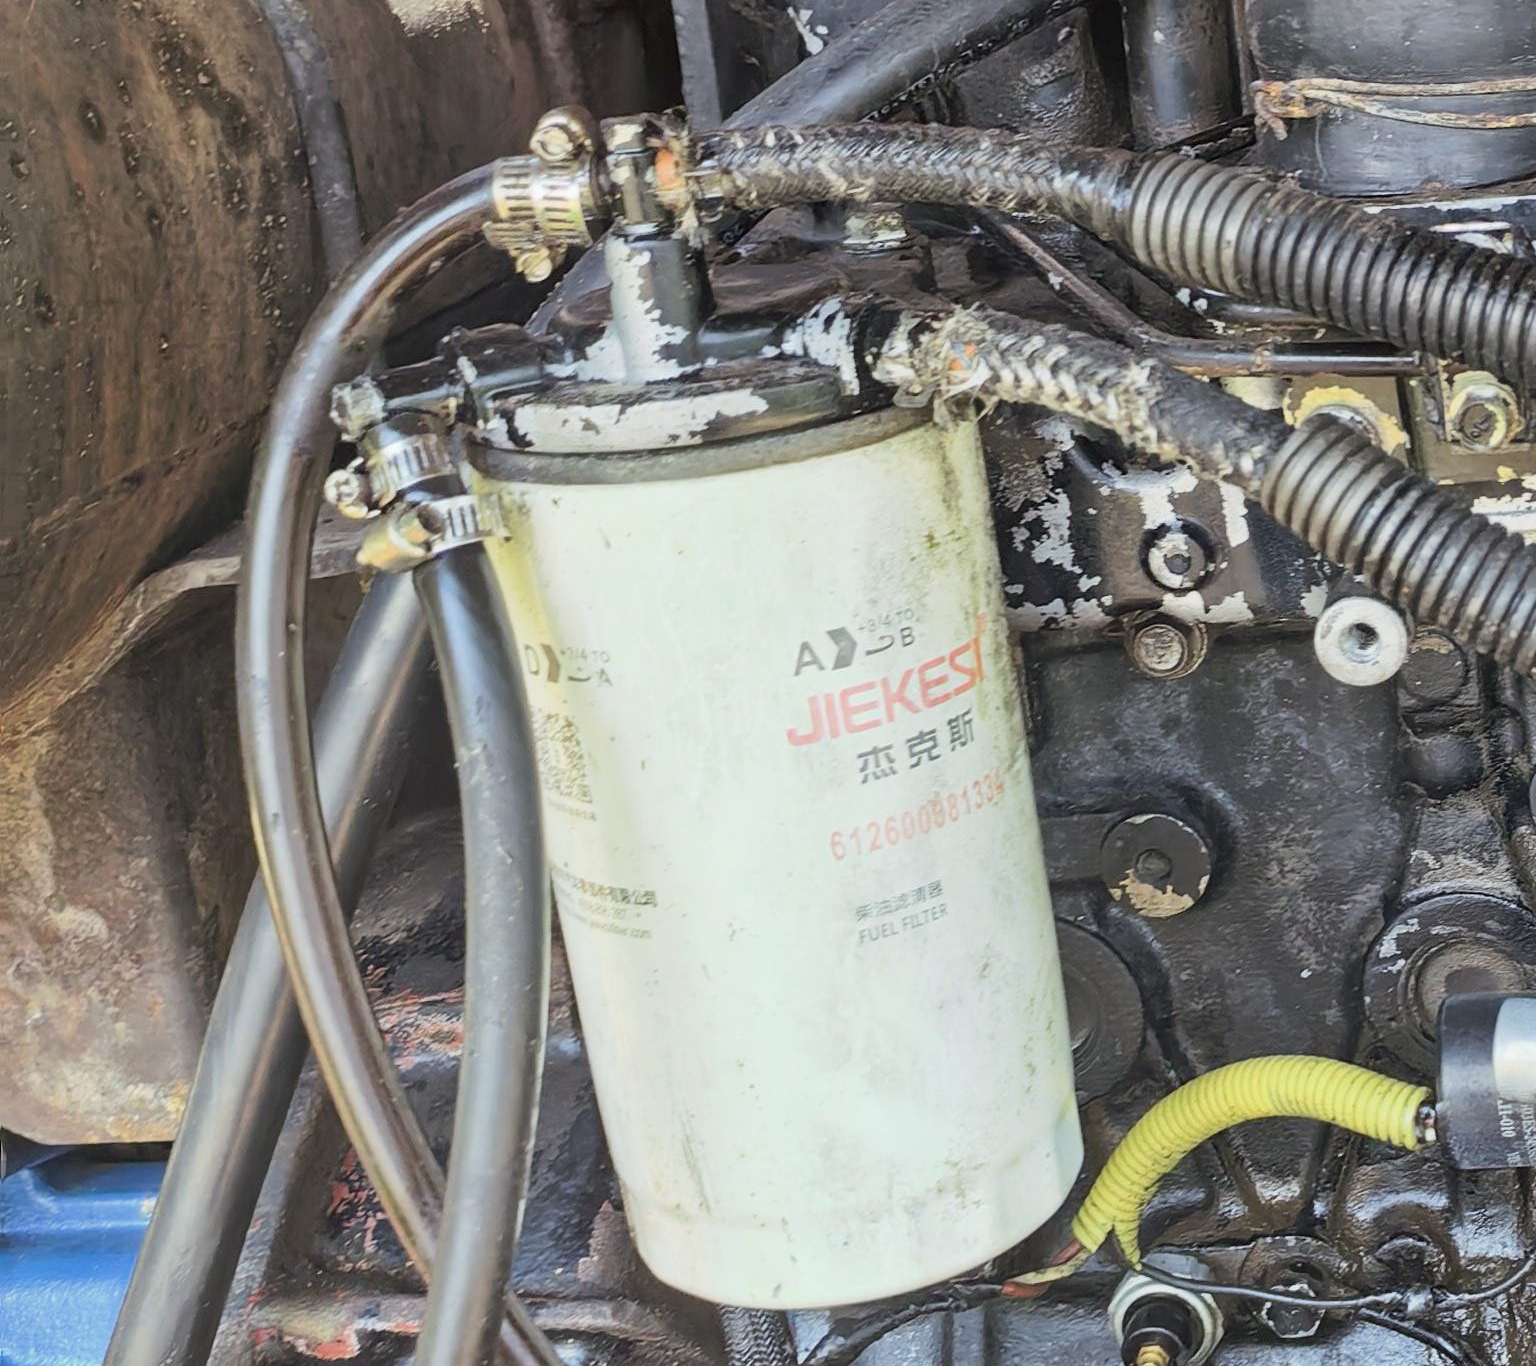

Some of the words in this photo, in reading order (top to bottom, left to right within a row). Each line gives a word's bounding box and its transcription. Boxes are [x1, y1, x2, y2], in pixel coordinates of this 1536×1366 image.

[793, 641, 826, 676] A
[900, 626, 916, 647] B
[856, 707, 974, 785] 杰克斯
[858, 921, 900, 947] FUEL
[901, 902, 948, 932] FILTER
